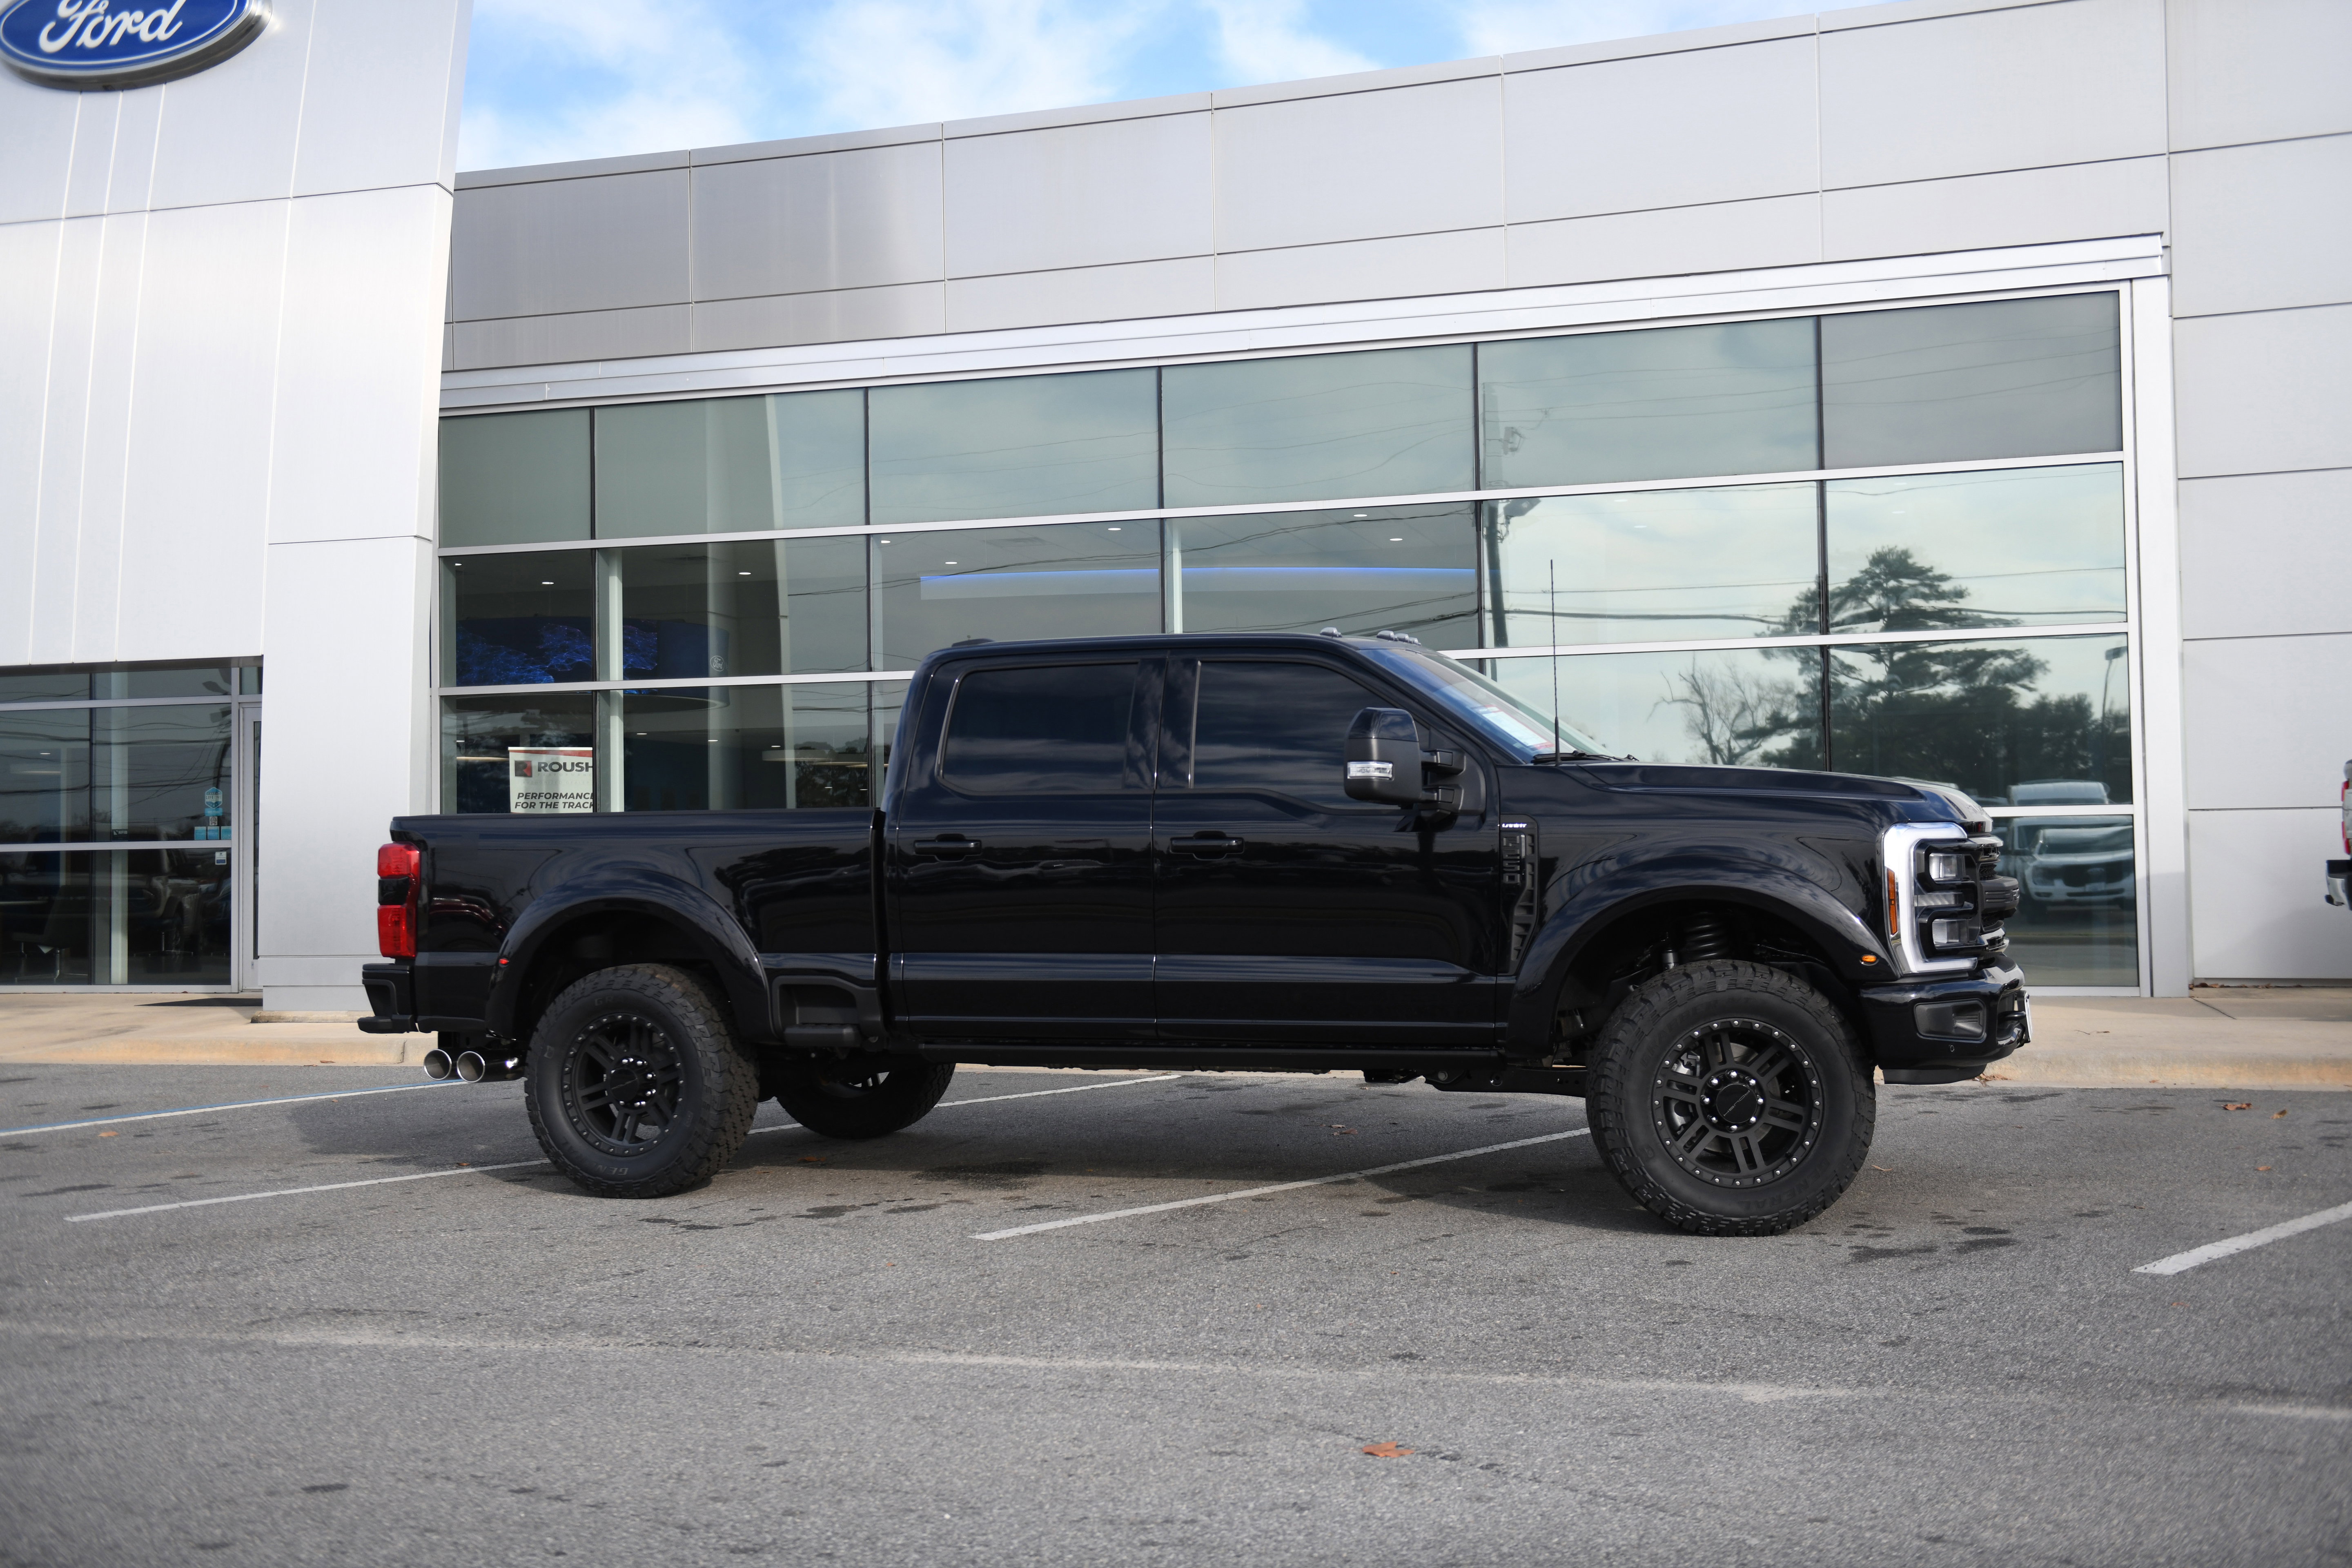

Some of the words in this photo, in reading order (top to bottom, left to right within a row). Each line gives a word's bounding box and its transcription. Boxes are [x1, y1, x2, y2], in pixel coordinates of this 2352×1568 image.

[39, 0, 186, 53] Ford
[713, 657, 723, 669] Ford
[537, 762, 593, 772] ROUSH
